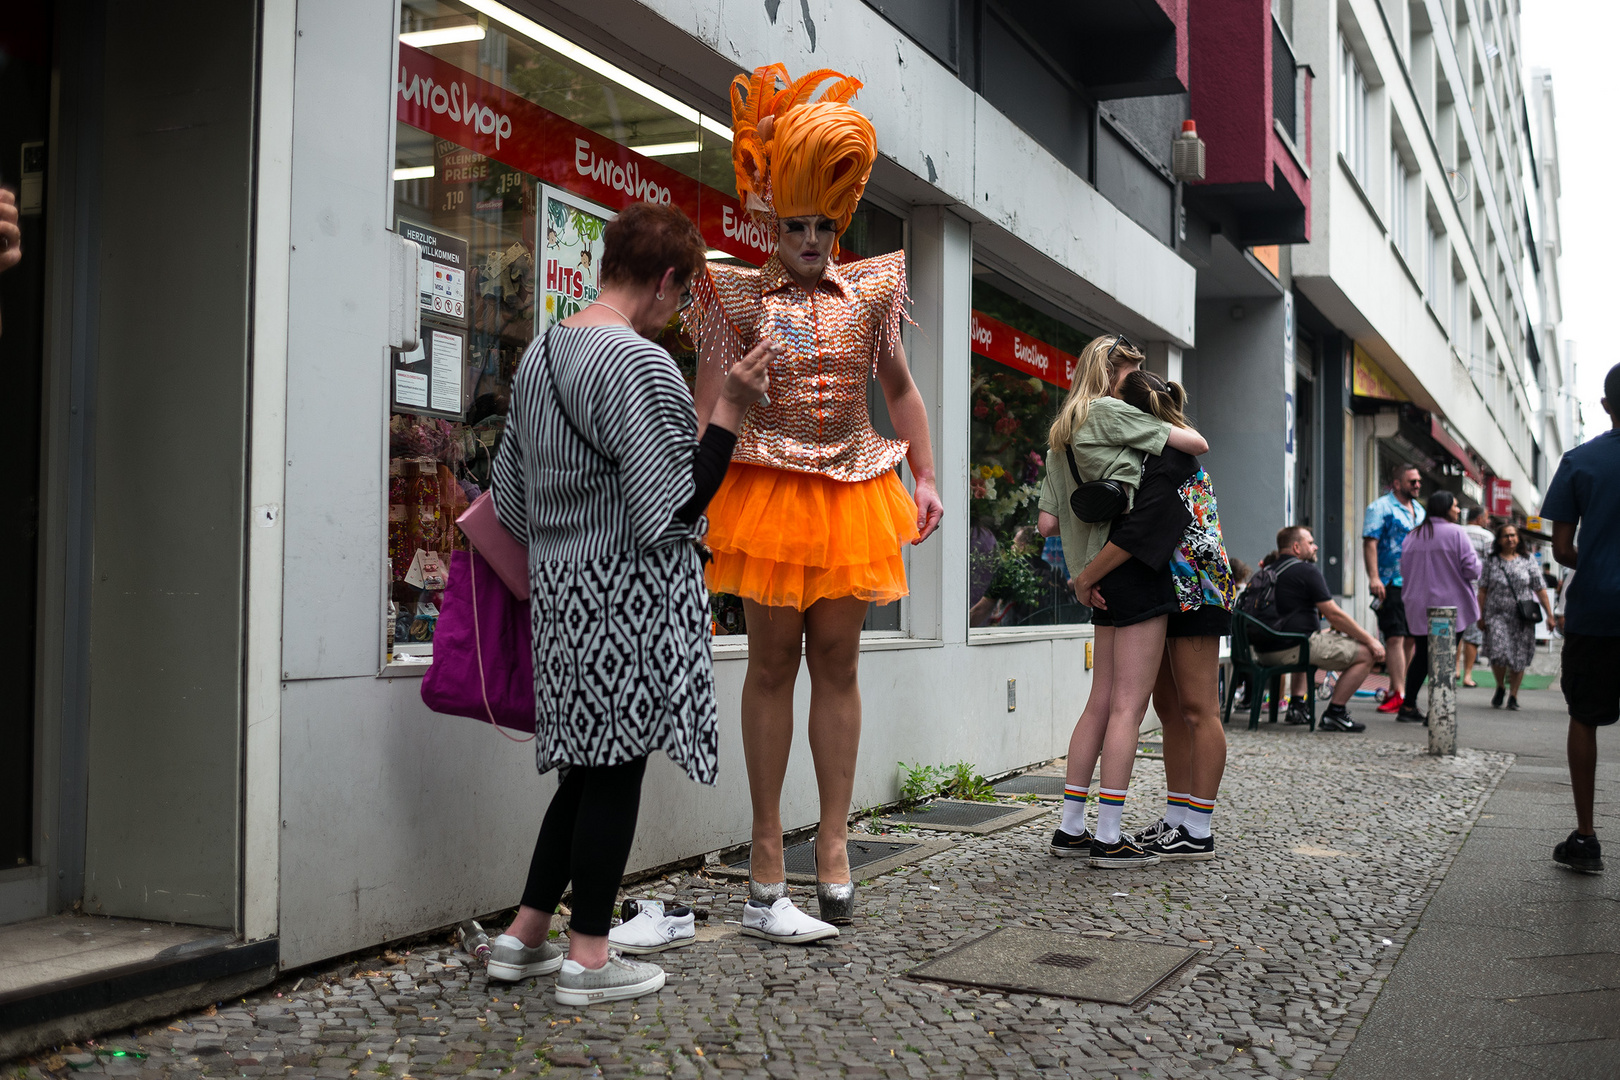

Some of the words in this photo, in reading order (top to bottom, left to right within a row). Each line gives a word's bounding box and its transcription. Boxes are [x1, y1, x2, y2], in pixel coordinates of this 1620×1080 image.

[398, 66, 512, 151] uroShop
[445, 153, 487, 166] KLEINSTE
[445, 166, 487, 181] PREISE
[575, 137, 671, 206] EuroShop
[407, 229, 437, 246] HERZLICH
[722, 205, 778, 254] EuroSh
[420, 245, 460, 264] WILLKOMMEN
[547, 259, 583, 299] HITS
[584, 284, 599, 301] FÜR
[971, 317, 992, 351] Shop
[1014, 336, 1049, 375] EuroShop
